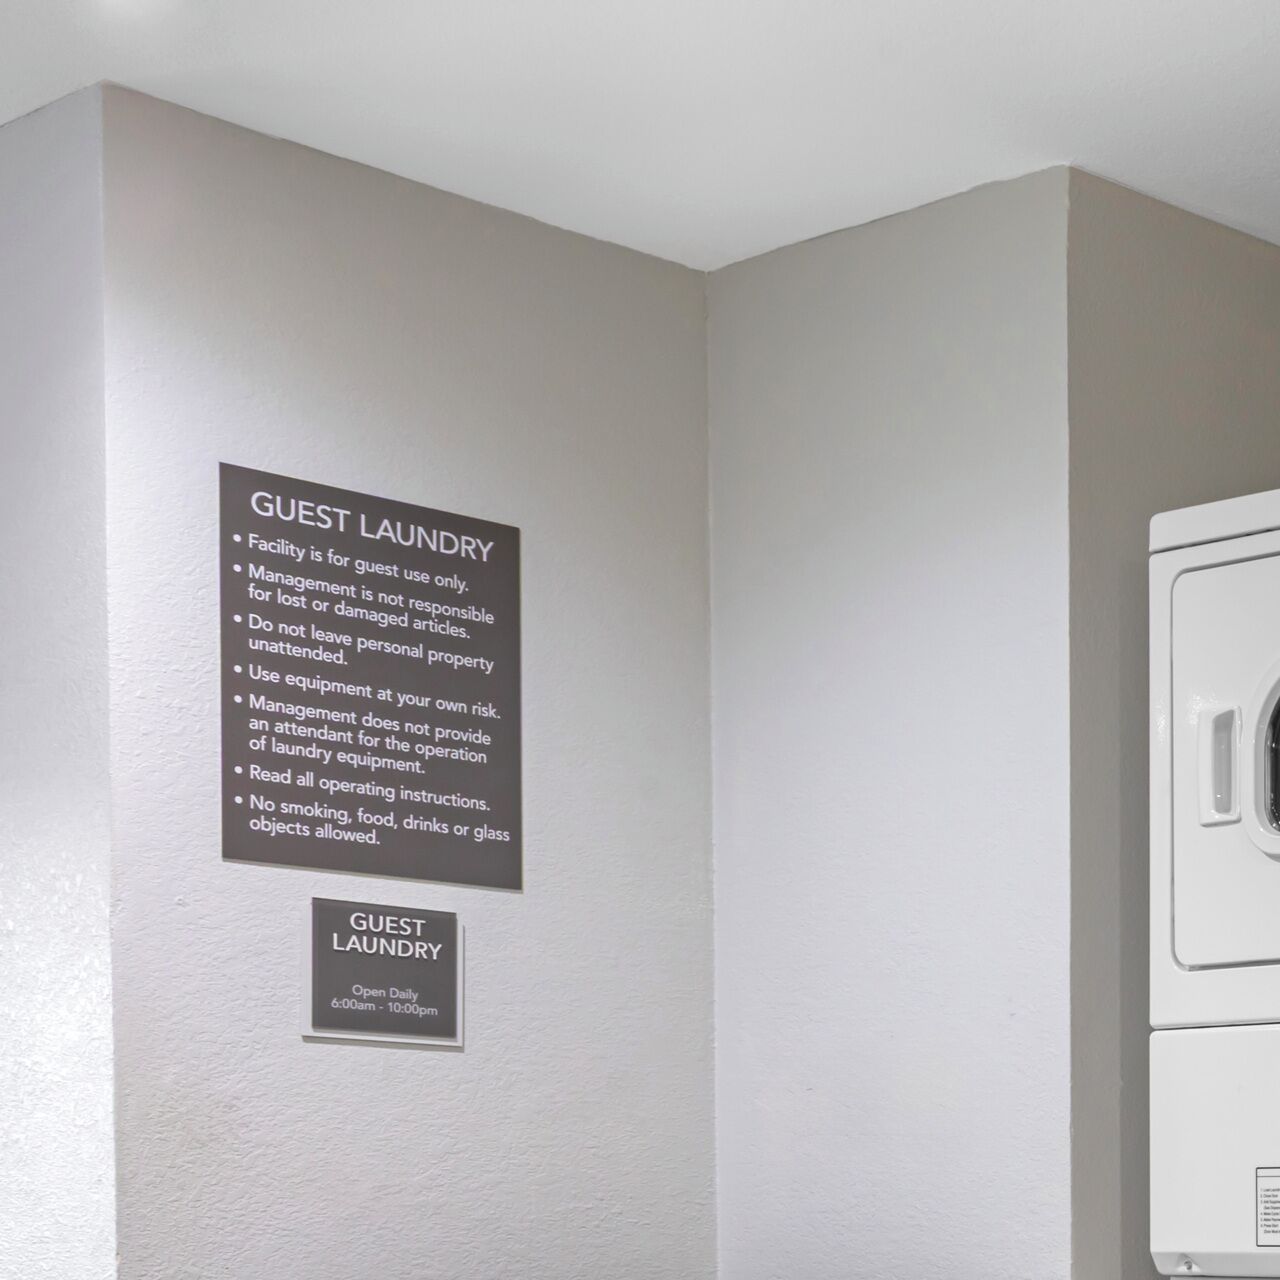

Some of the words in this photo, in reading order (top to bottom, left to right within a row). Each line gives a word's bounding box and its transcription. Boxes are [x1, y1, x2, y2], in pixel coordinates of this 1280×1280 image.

[251, 491, 350, 532] GUEST
[360, 513, 494, 562] LAUNDRY
[248, 533, 305, 559] Facility
[310, 546, 323, 562] is
[327, 548, 350, 567] for
[355, 558, 399, 578] guest
[404, 567, 430, 583] use
[435, 573, 469, 593] only.
[248, 583, 272, 600] for
[278, 589, 307, 609] lost
[312, 596, 329, 611] or
[335, 599, 408, 628] damaged
[413, 616, 470, 639] articles.
[249, 563, 356, 599] Management
[361, 584, 373, 601] is
[378, 589, 404, 606] not
[409, 598, 494, 625] responsible
[249, 613, 273, 632] Do
[279, 620, 305, 637] not
[311, 625, 352, 645] leave
[357, 636, 423, 659] personal
[428, 649, 494, 674] property
[249, 639, 348, 665] unattended.
[249, 664, 280, 683] Use
[285, 673, 372, 699] equipment
[378, 687, 393, 702] at
[397, 691, 431, 709] your
[436, 698, 468, 714] own
[472, 702, 501, 719] risk.
[249, 718, 269, 731] an
[275, 720, 353, 744] attendant
[358, 731, 381, 748] for
[385, 736, 410, 752] the
[415, 743, 487, 764] operation
[250, 694, 357, 725] Management
[362, 711, 400, 731] does
[405, 720, 431, 736] not
[436, 724, 491, 745] provide
[249, 734, 267, 751] of
[272, 738, 332, 765] laundry
[337, 751, 425, 774] equipment.
[250, 764, 291, 784] Read
[297, 772, 313, 788] all
[319, 777, 395, 801] operating
[400, 785, 490, 811] instructions.
[249, 816, 310, 838] objects
[315, 823, 380, 845] allowed.
[250, 794, 275, 812] No
[280, 800, 351, 825] smoking,
[357, 810, 398, 830] food,
[403, 815, 449, 834] drinks
[453, 824, 469, 837] or
[474, 824, 510, 842] glass
[333, 932, 443, 961] LAUNDRY
[350, 912, 426, 937] GUEST
[331, 998, 376, 1011] 6:00am
[388, 1002, 438, 1018] 10:00pm
[352, 984, 386, 999] Open
[389, 987, 418, 1002] Daily
